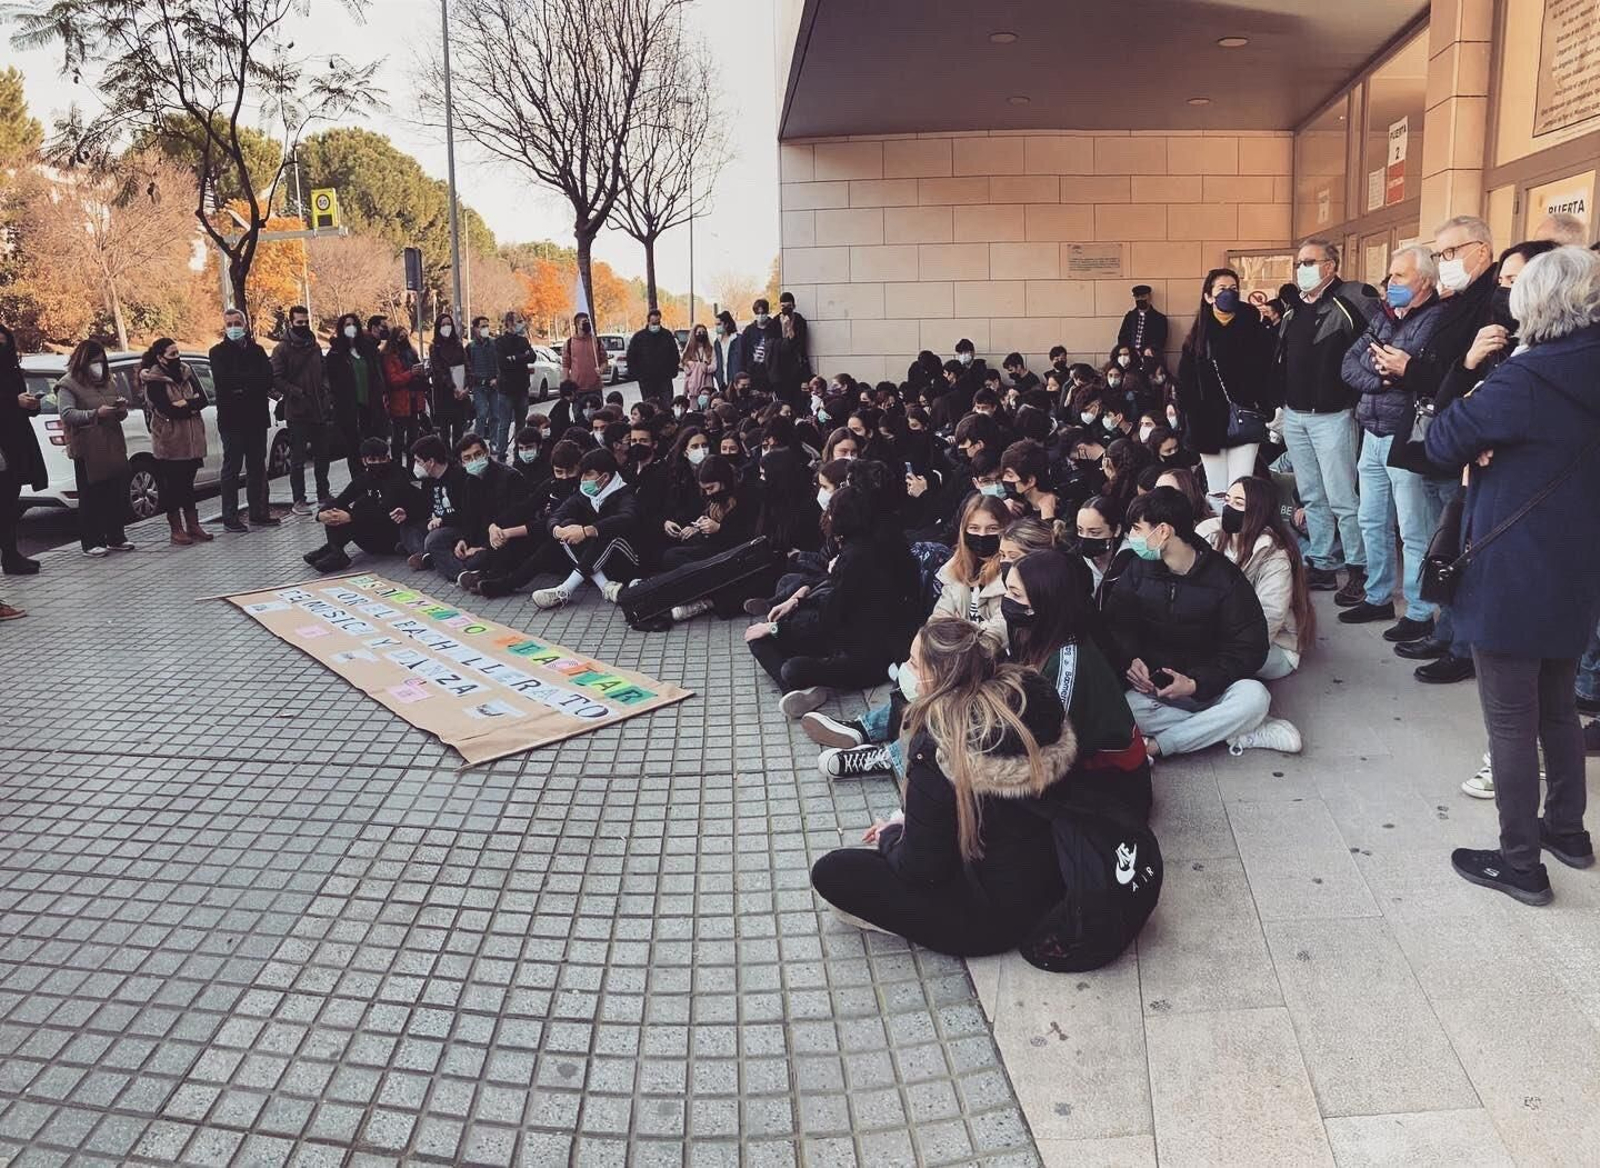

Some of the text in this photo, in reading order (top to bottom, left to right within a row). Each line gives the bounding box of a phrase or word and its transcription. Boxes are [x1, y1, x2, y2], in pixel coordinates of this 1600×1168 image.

[375, 588, 487, 634] MMETO
[325, 588, 368, 606] OR
[394, 620, 609, 719] BACHLLERATO
[1132, 866, 1154, 892] AIR
